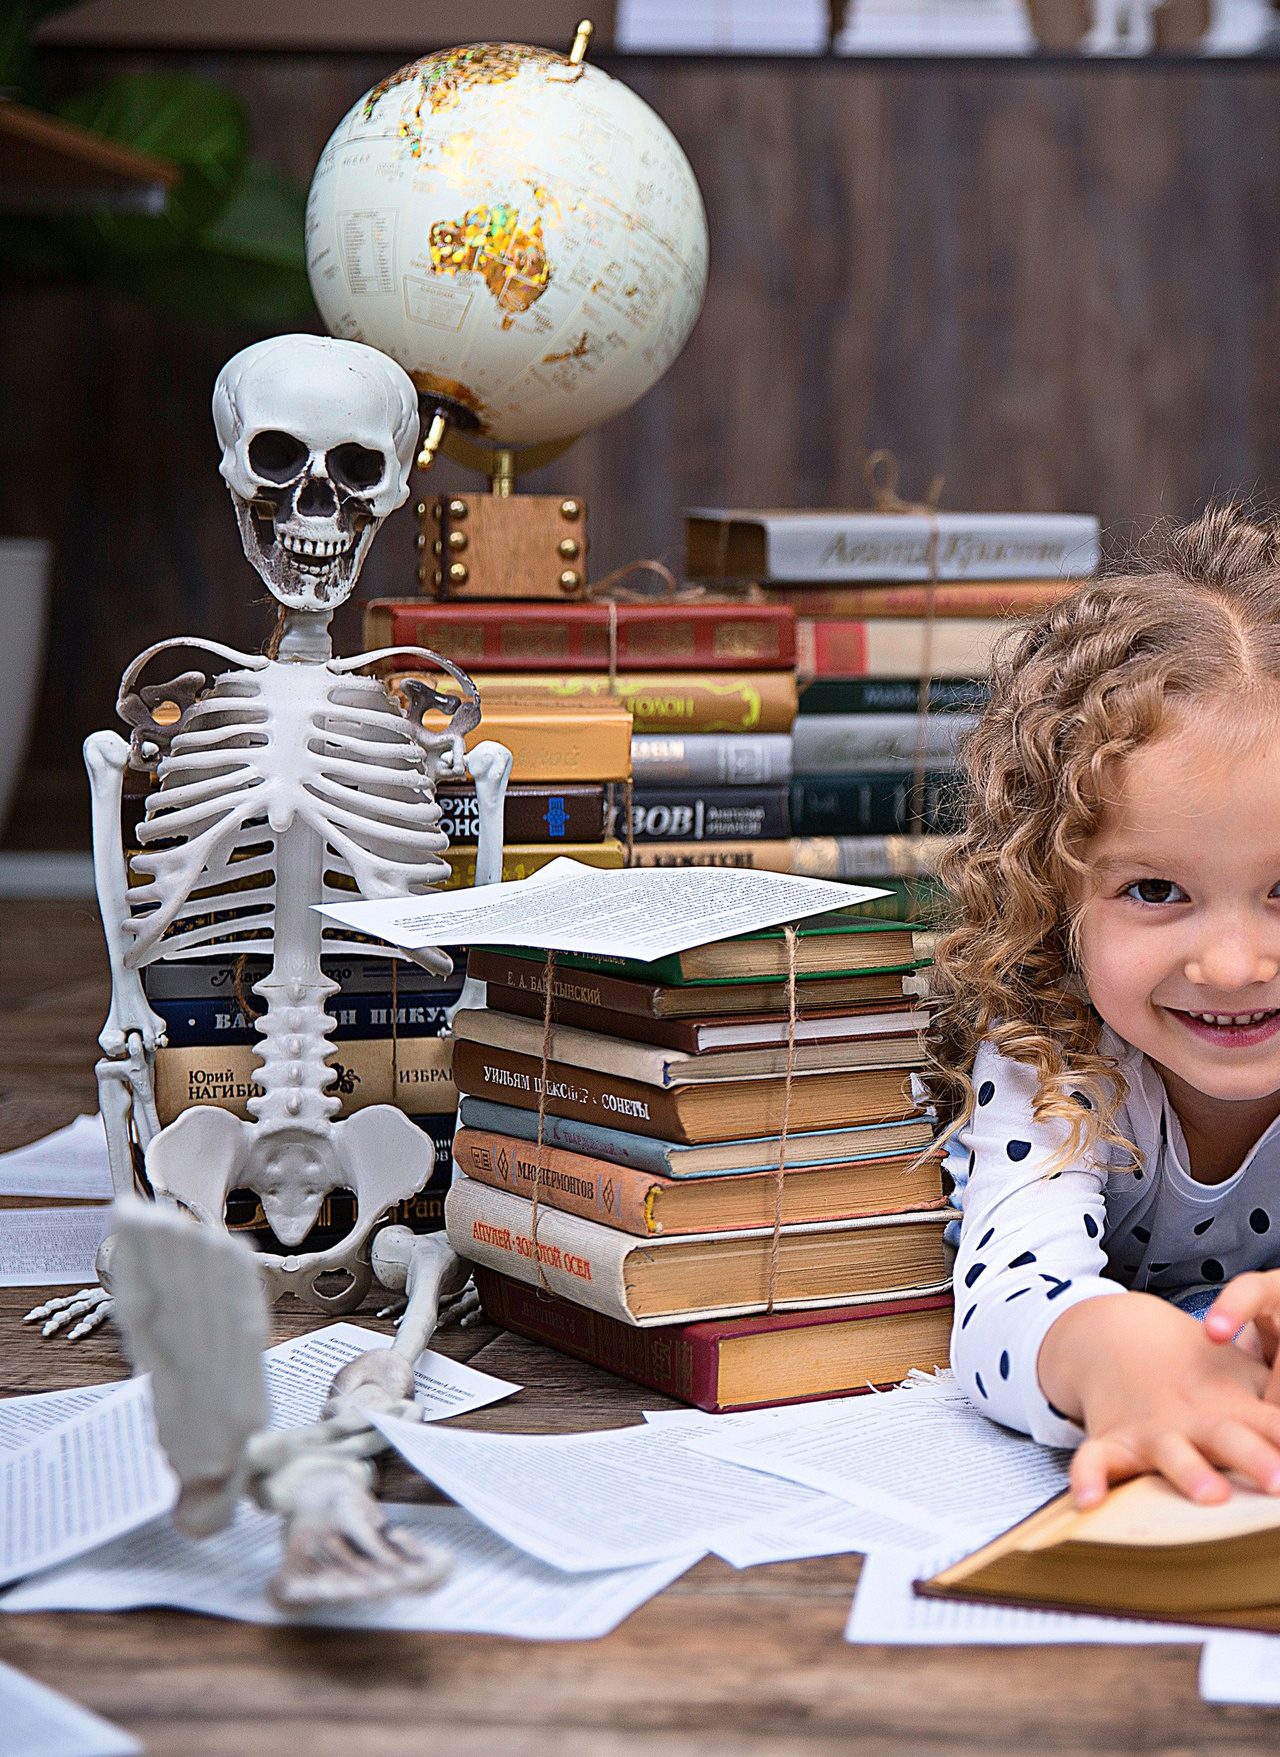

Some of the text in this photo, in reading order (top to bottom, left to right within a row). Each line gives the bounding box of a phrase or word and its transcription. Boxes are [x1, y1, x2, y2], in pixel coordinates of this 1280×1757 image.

[507, 971, 516, 985] Е.
[530, 976, 601, 1005] БАРТЫНСКИЙ
[188, 1068, 235, 1087] Юрий
[188, 1084, 266, 1101] НАГИБИ
[483, 1065, 531, 1092] УИЛЬЯМ
[601, 1093, 651, 1121] СОНЕТЫ
[472, 1220, 513, 1252] АПУЛЕЙ
[563, 1252, 593, 1281] ОСЕЛ
